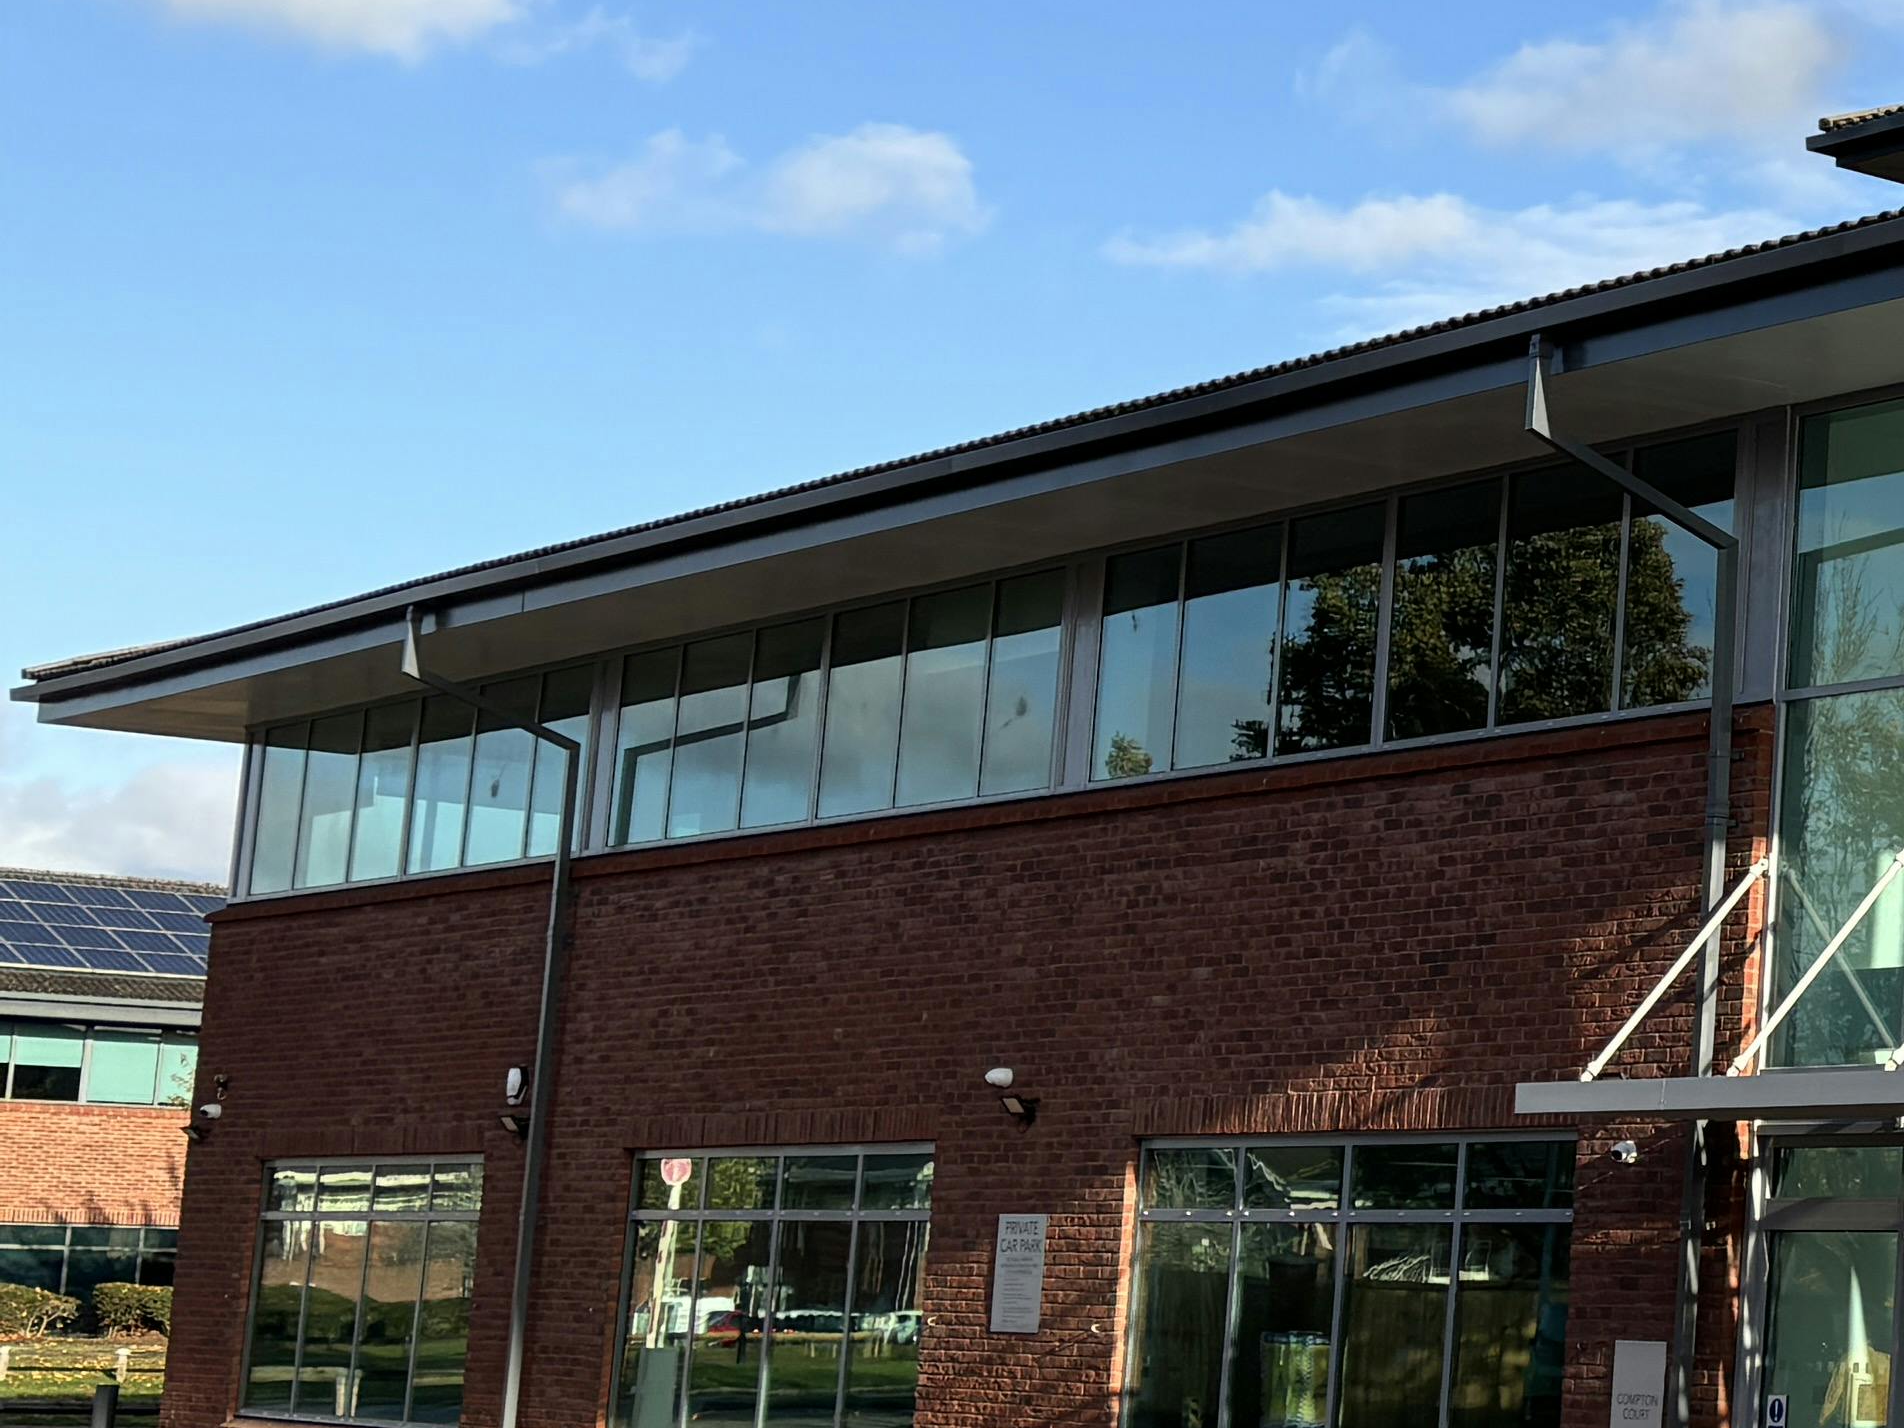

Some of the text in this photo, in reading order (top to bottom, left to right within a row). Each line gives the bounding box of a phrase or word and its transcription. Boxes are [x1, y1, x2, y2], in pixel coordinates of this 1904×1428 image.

[1005, 1221, 1039, 1235] PRIVATE
[1000, 1238, 1042, 1253] CAR PARK
